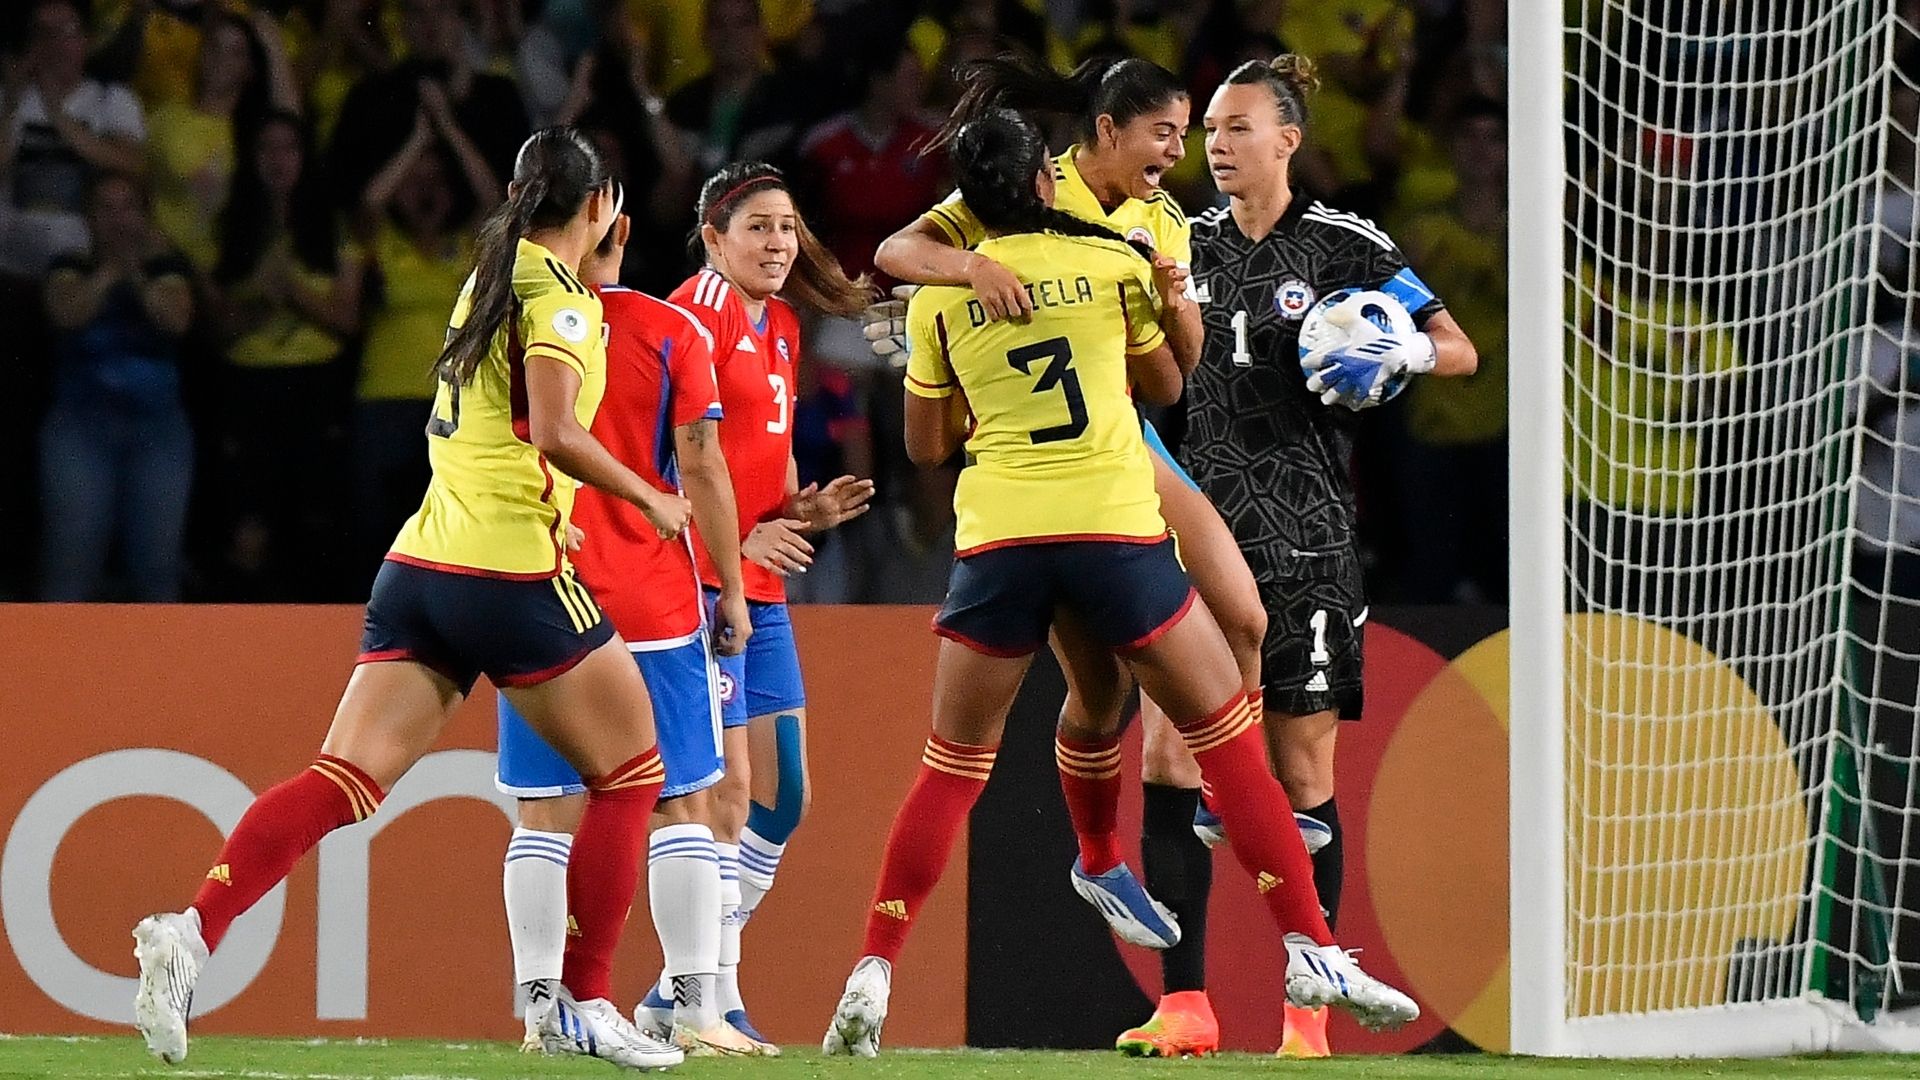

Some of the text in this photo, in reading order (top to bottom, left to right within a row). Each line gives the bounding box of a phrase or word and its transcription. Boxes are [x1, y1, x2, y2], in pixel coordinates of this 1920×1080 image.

[966, 276, 1093, 328] DIELA
[1231, 310, 1253, 367] 1
[766, 374, 787, 434] 3
[1007, 336, 1089, 444] 3
[1310, 610, 1330, 666] 1
